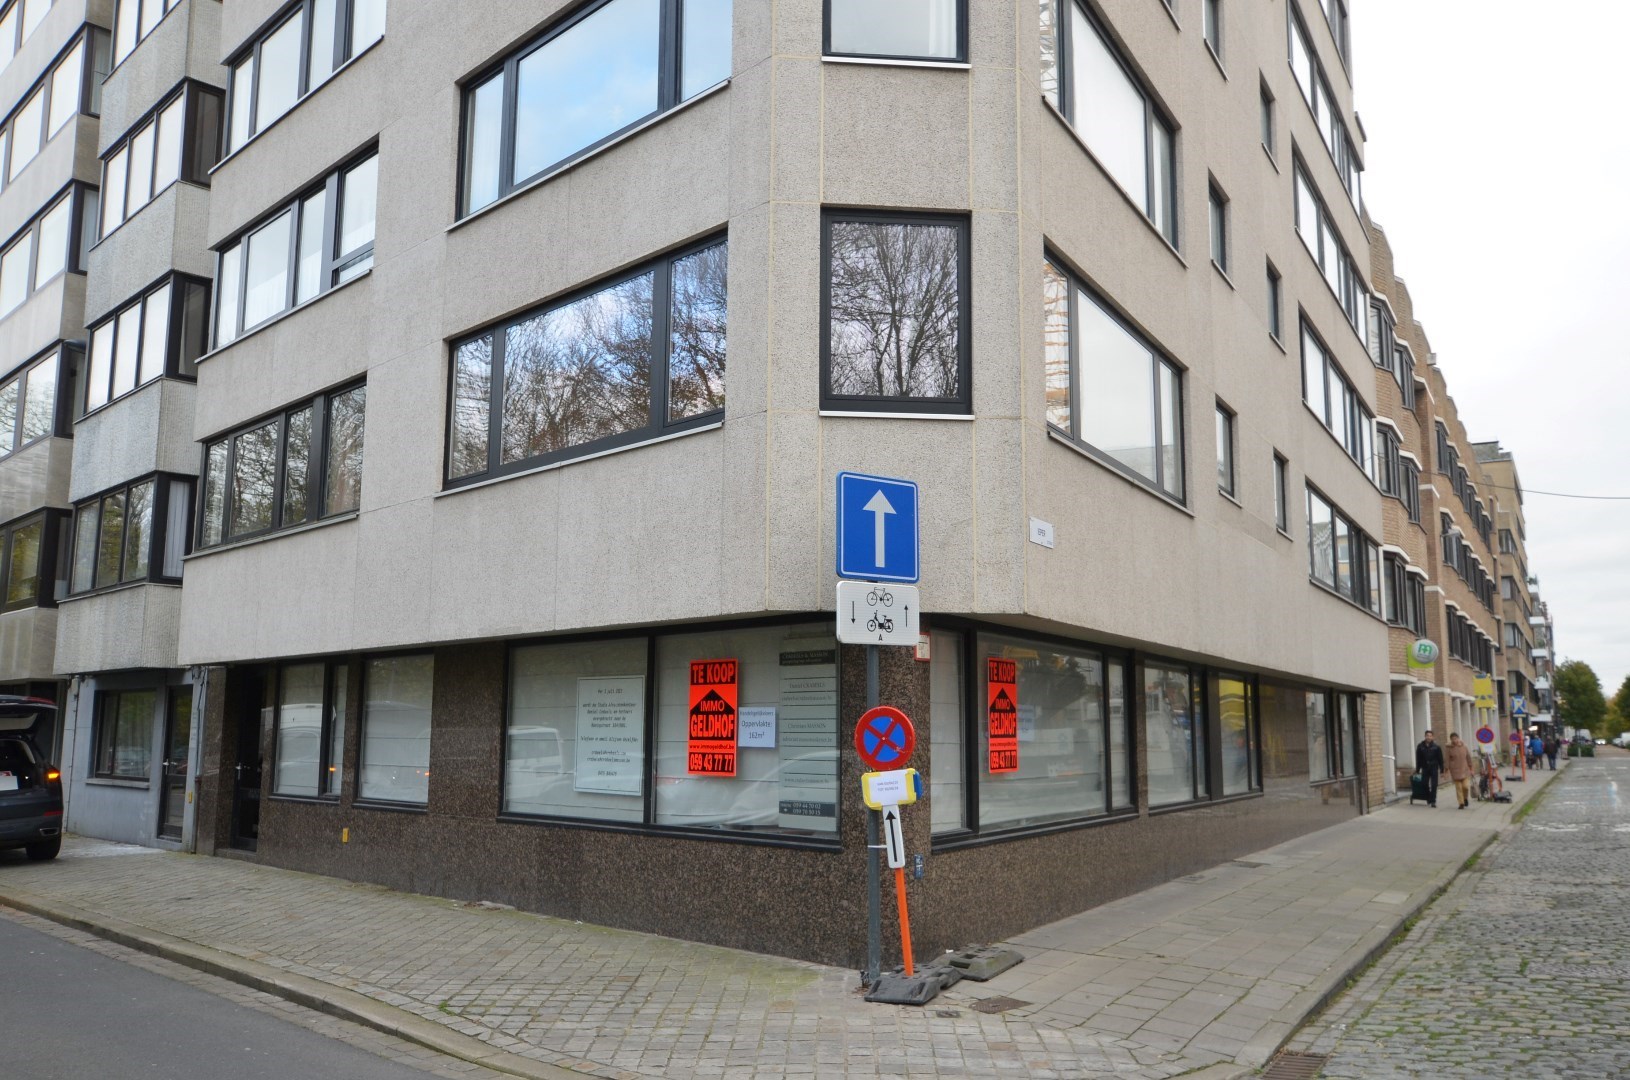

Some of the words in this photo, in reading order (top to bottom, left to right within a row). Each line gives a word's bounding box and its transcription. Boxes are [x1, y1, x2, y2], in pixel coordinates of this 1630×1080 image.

[877, 633, 883, 642] A
[692, 665, 704, 684] TE
[707, 663, 734, 683] KOOP
[989, 662, 998, 682] TE
[998, 662, 1015, 683] KOOP
[700, 700, 725, 712] IMMO
[995, 698, 1011, 710] IMMO
[691, 714, 734, 738] GELDHOF
[990, 712, 1017, 736] GELDHOF
[690, 753, 703, 770] 059
[703, 754, 713, 771] 43
[714, 754, 723, 771] 77
[724, 754, 734, 772] 77
